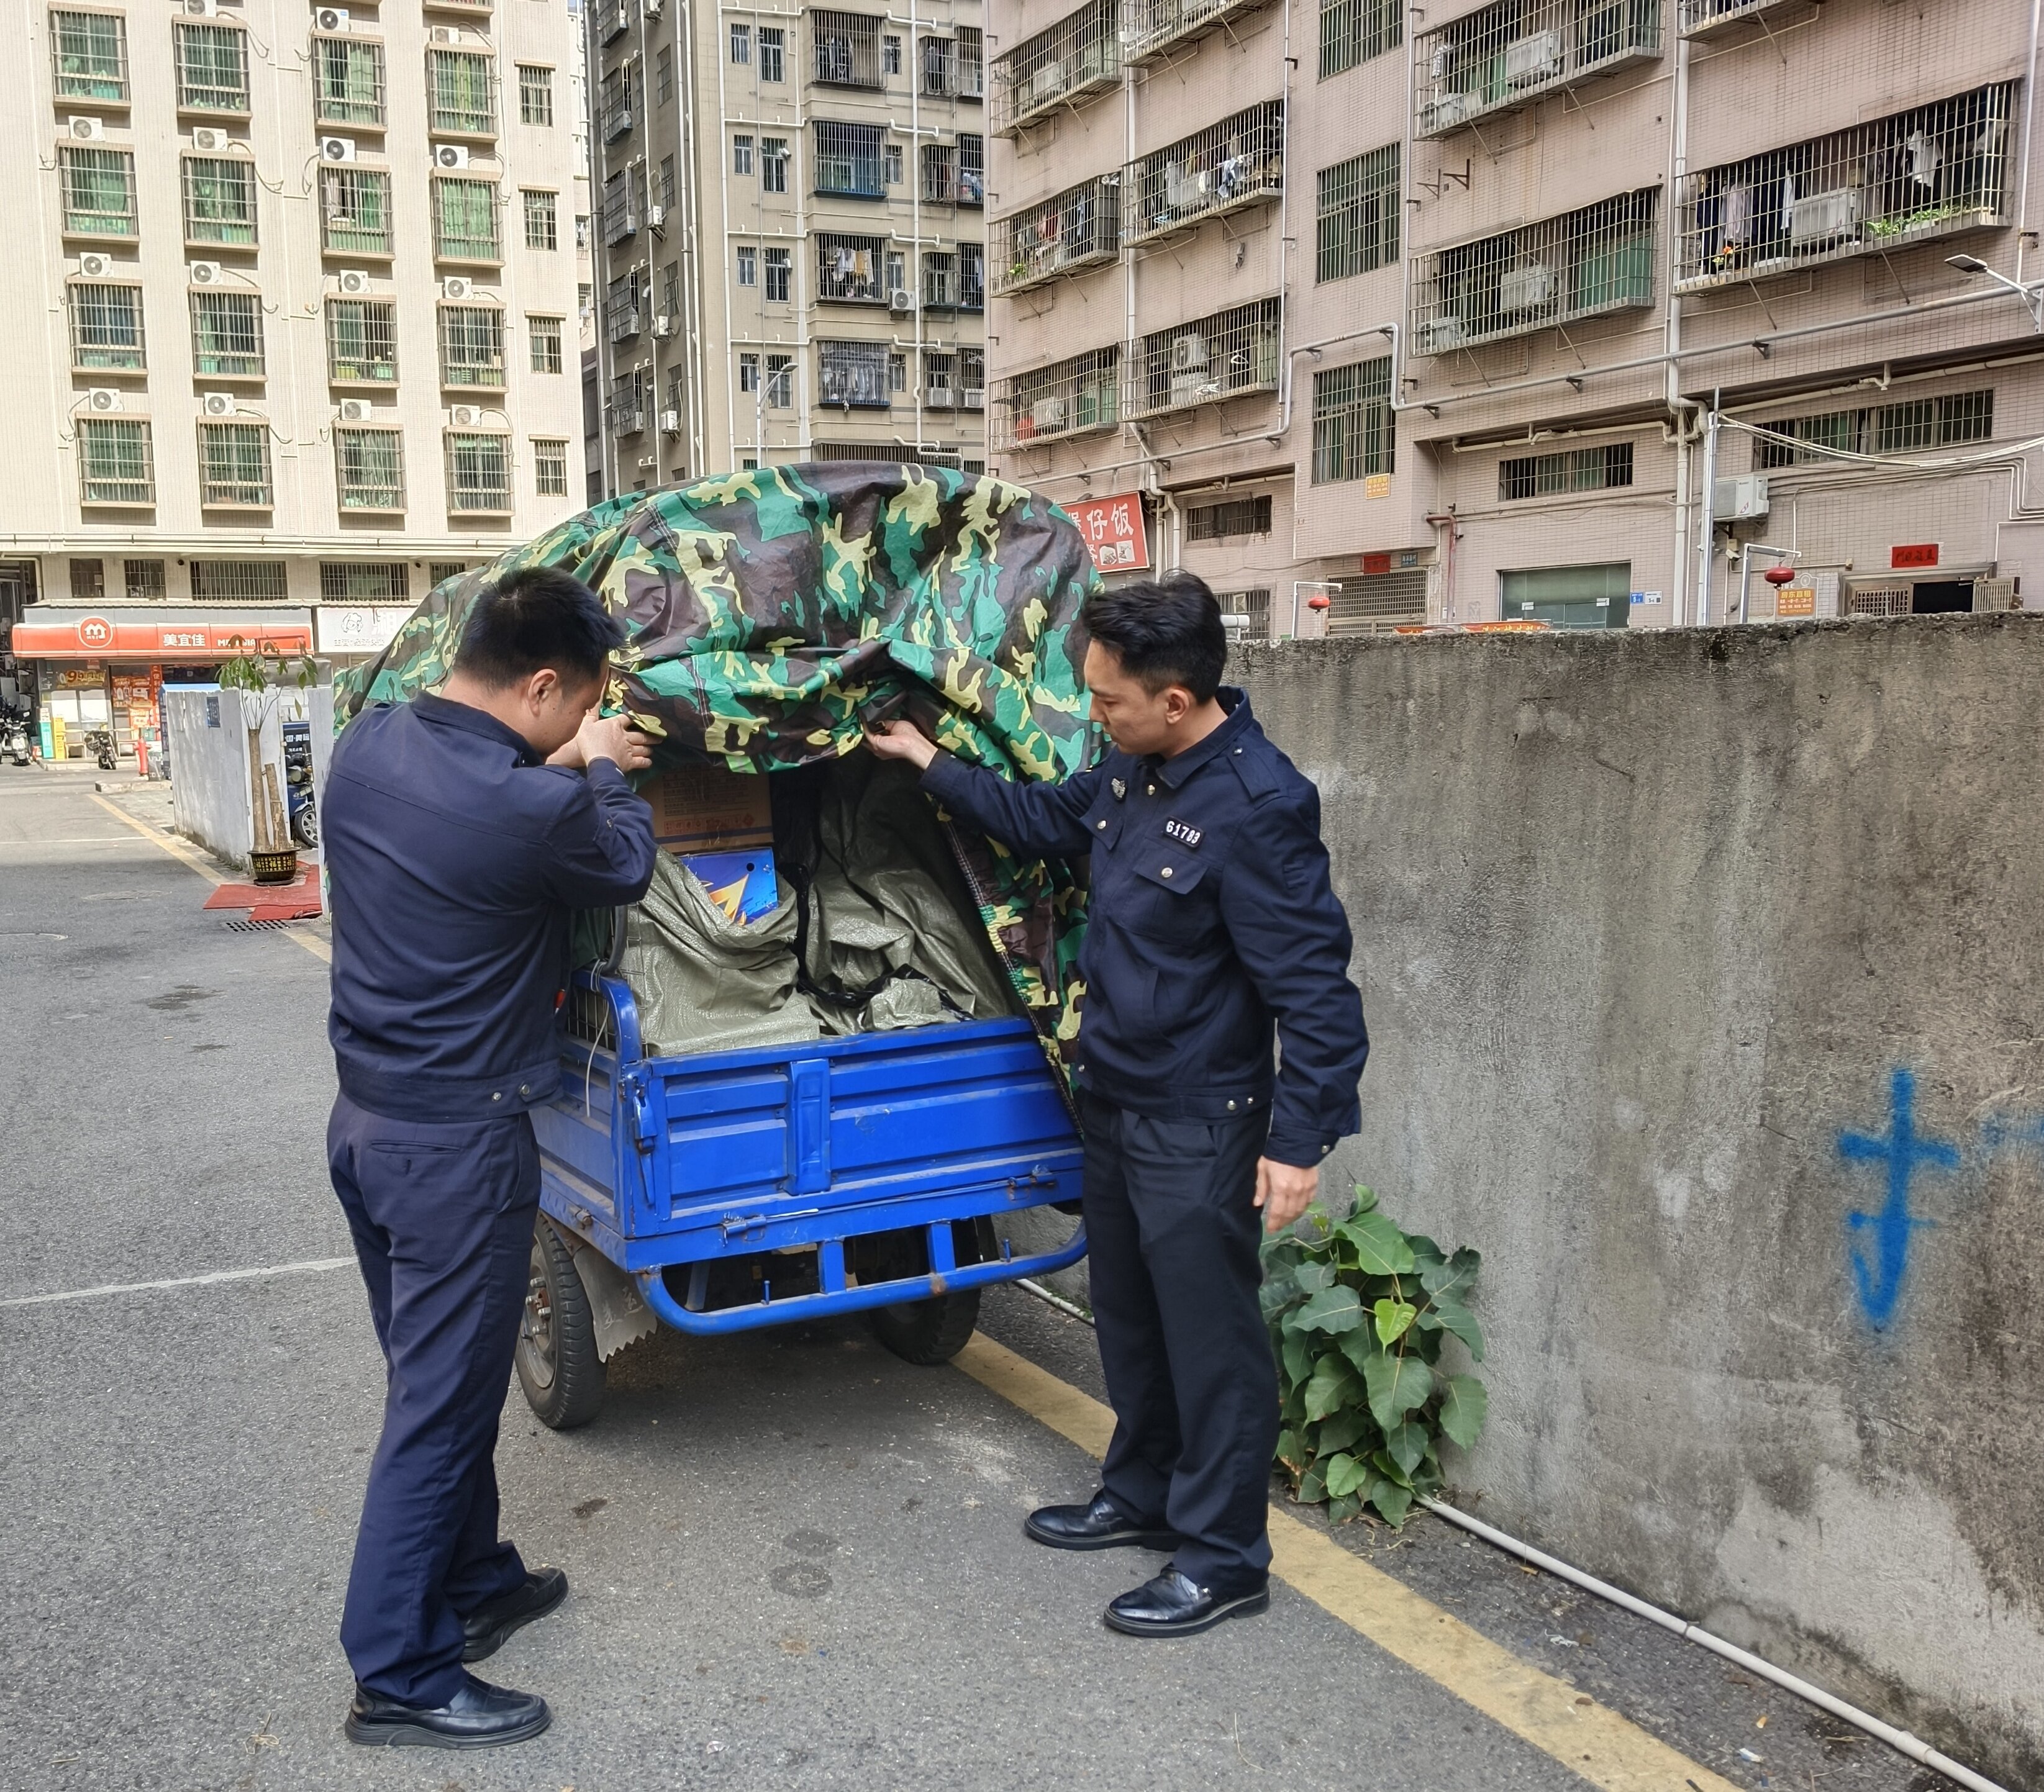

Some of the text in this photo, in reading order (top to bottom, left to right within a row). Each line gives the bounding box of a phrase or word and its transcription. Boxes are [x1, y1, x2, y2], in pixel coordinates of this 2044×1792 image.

[163, 633, 206, 647] 美宜佳
[1166, 820, 1201, 844] 61783
